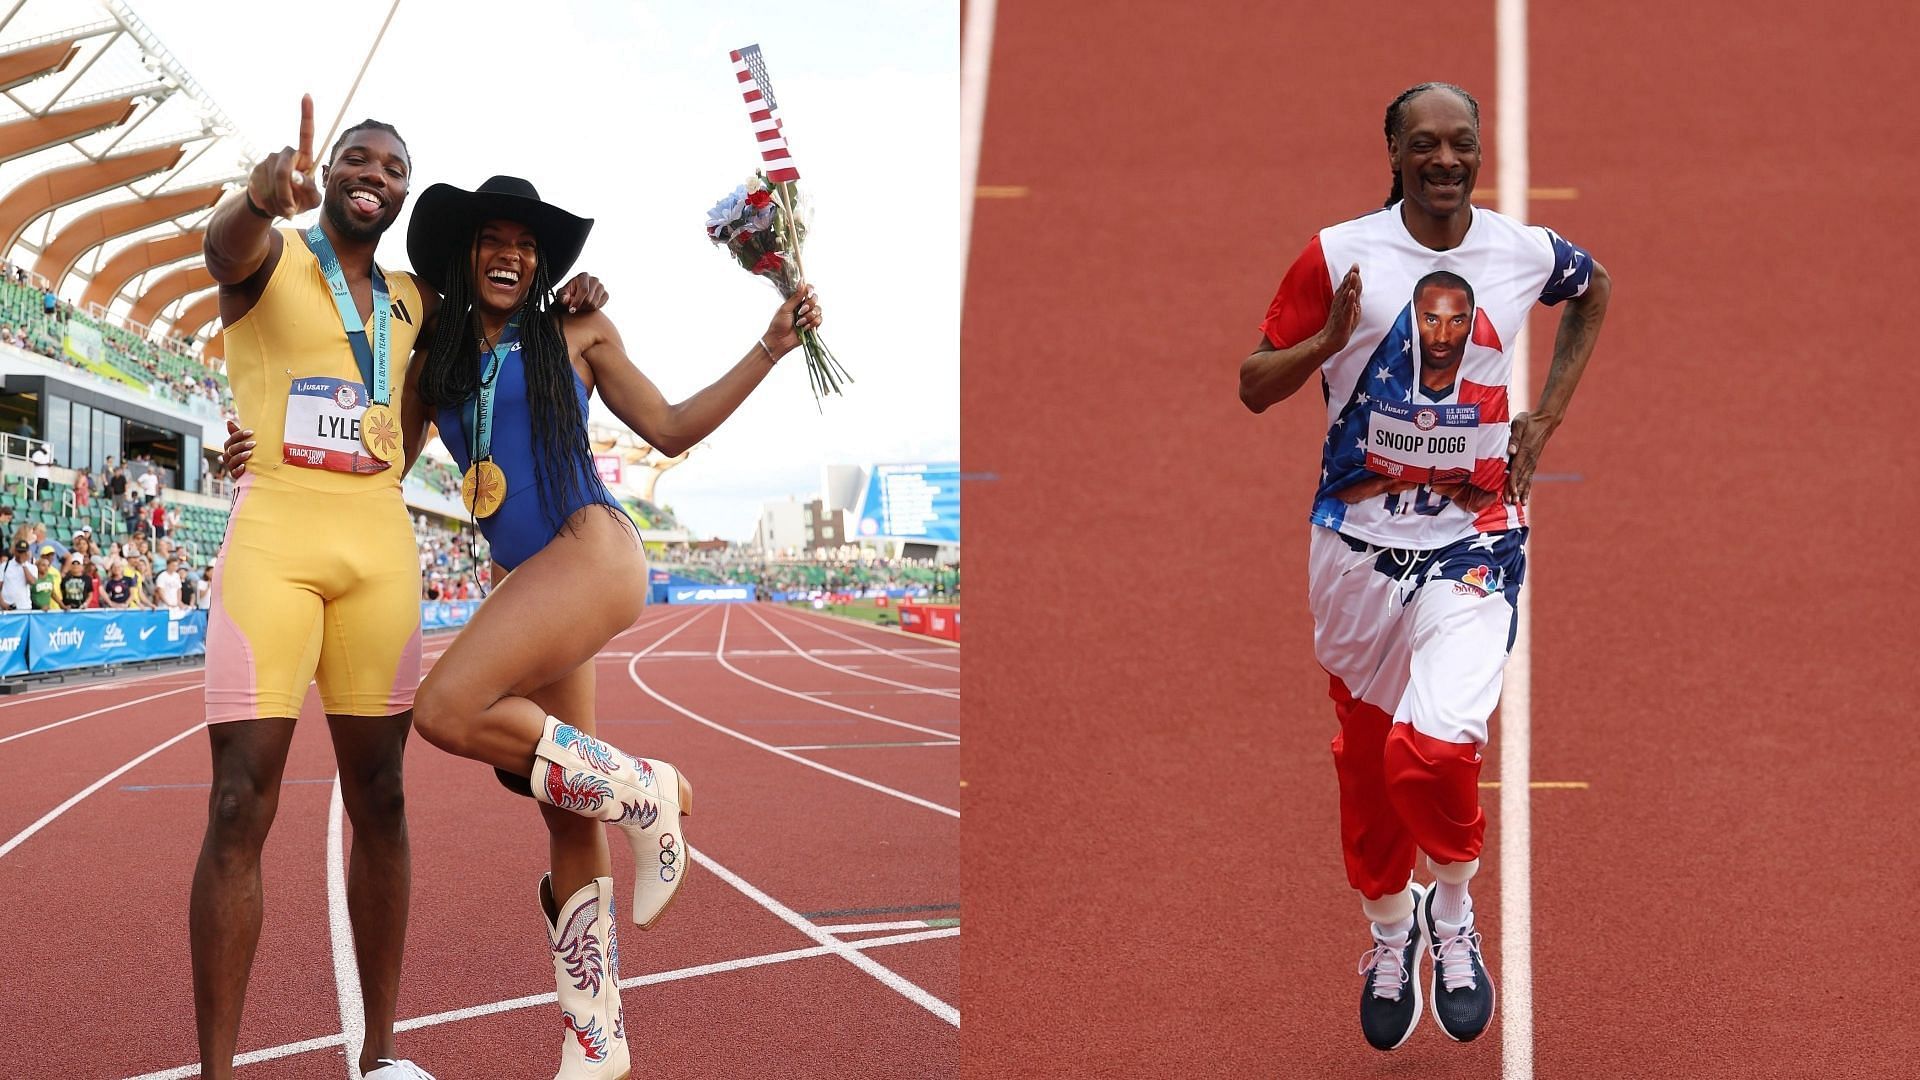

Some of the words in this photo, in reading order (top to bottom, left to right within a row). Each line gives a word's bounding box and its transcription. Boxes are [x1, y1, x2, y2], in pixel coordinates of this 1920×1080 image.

[379, 310, 387, 331] TRIALS
[378, 350, 386, 378] OLYMPIC
[479, 391, 490, 420] OLYMPIC
[1387, 406, 1409, 416] USATF
[288, 447, 326, 459] TRACKTOWN
[1375, 429, 1424, 453] SNOOP
[1427, 436, 1466, 454] DOGG
[307, 456, 324, 465] 2024
[48, 626, 85, 651] xfinity
